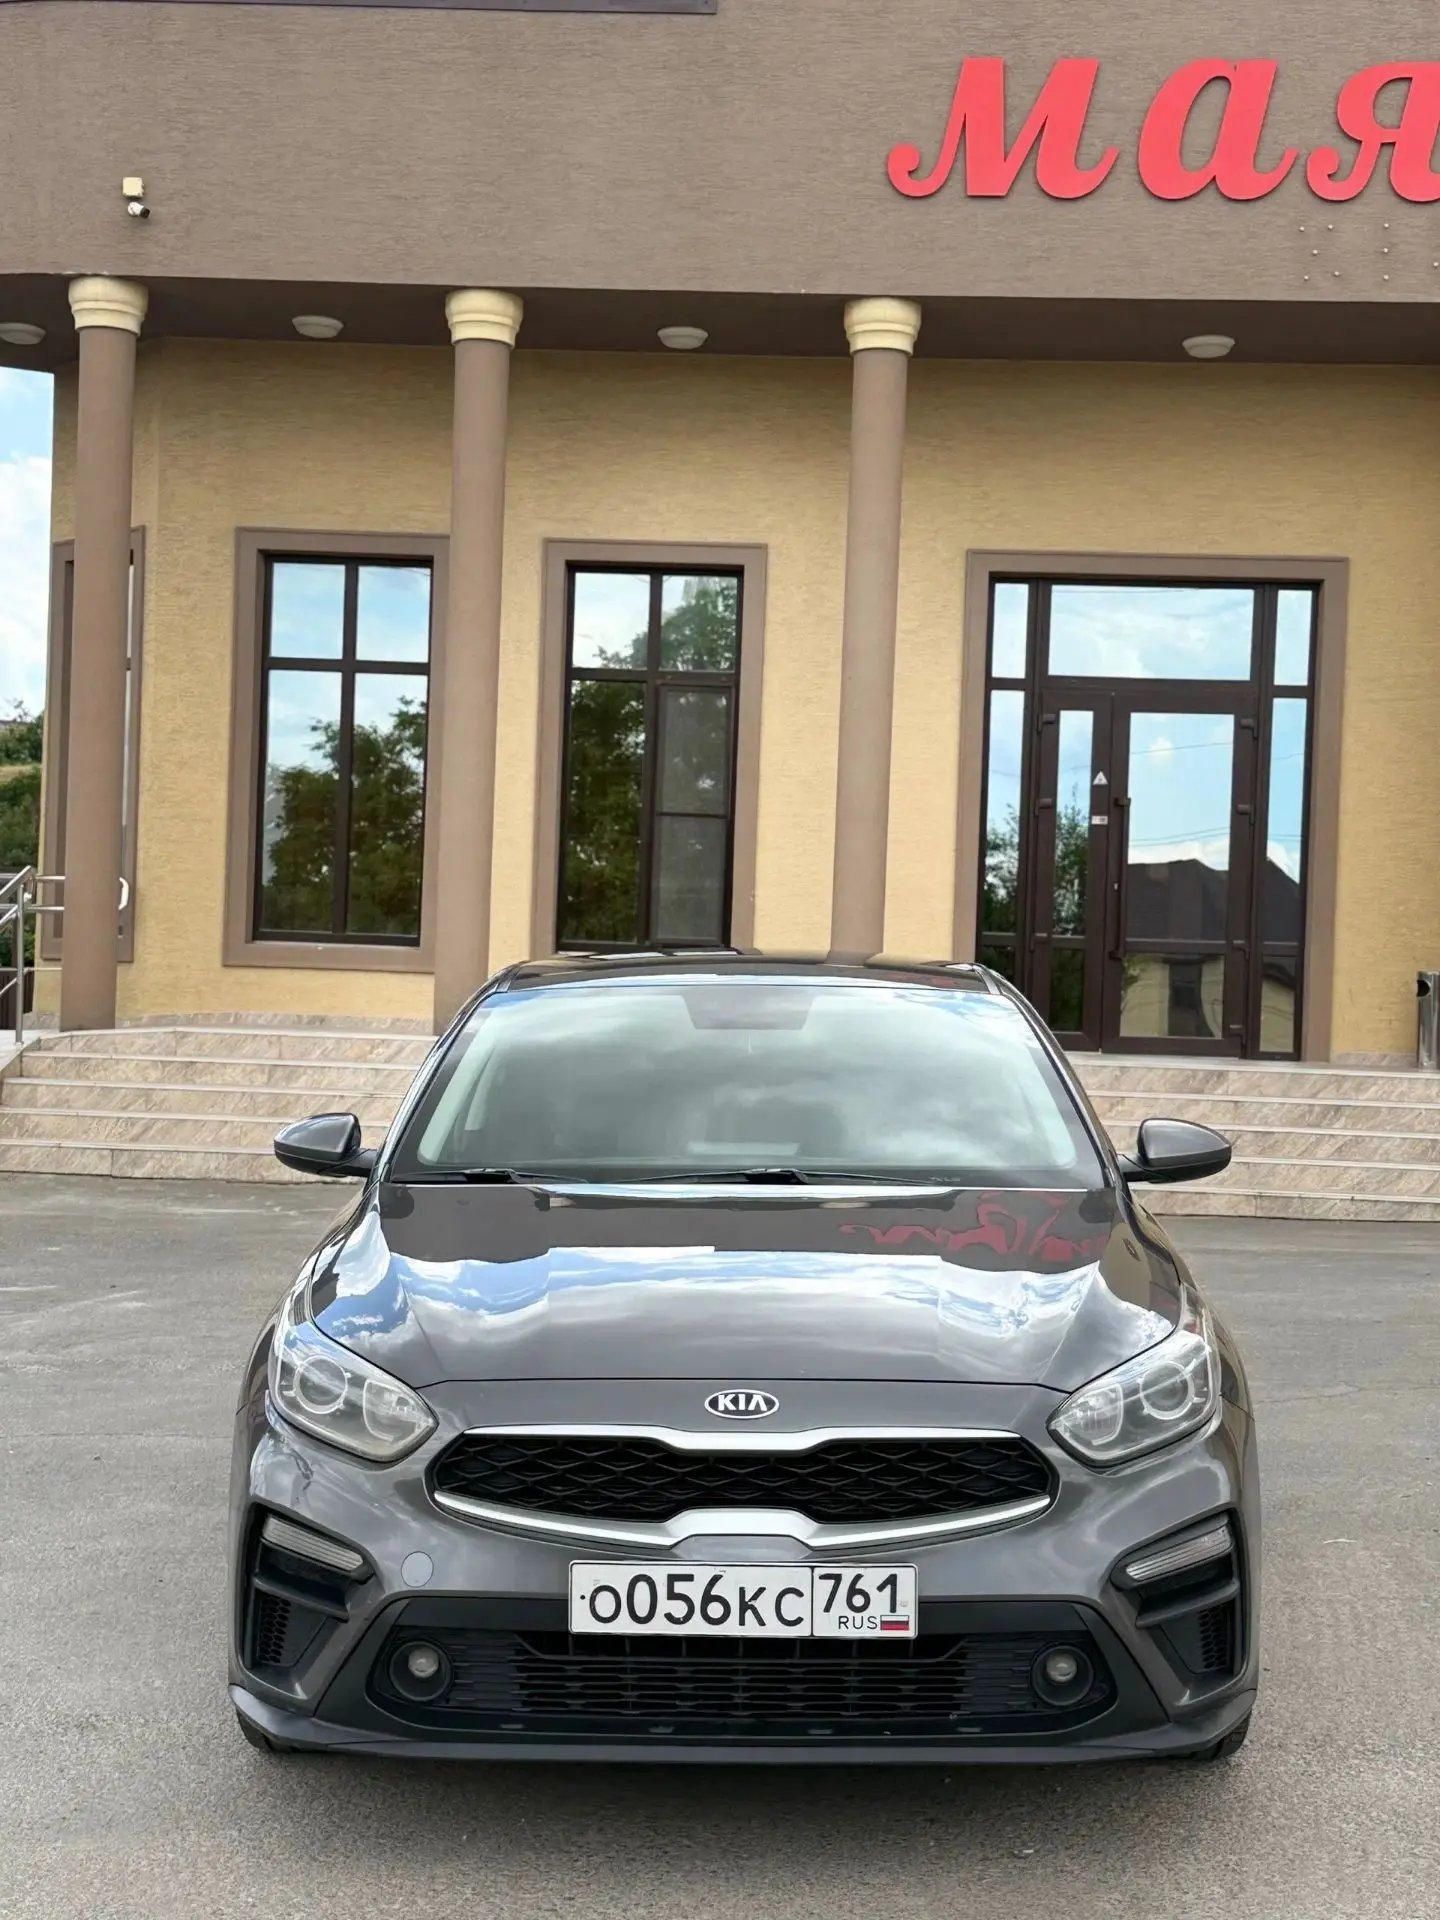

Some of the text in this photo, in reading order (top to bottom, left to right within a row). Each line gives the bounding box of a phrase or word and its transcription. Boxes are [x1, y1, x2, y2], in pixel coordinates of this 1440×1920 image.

[718, 1394, 767, 1411] KIA
[818, 1573, 899, 1614] 761
[838, 1615, 878, 1630] RUS
